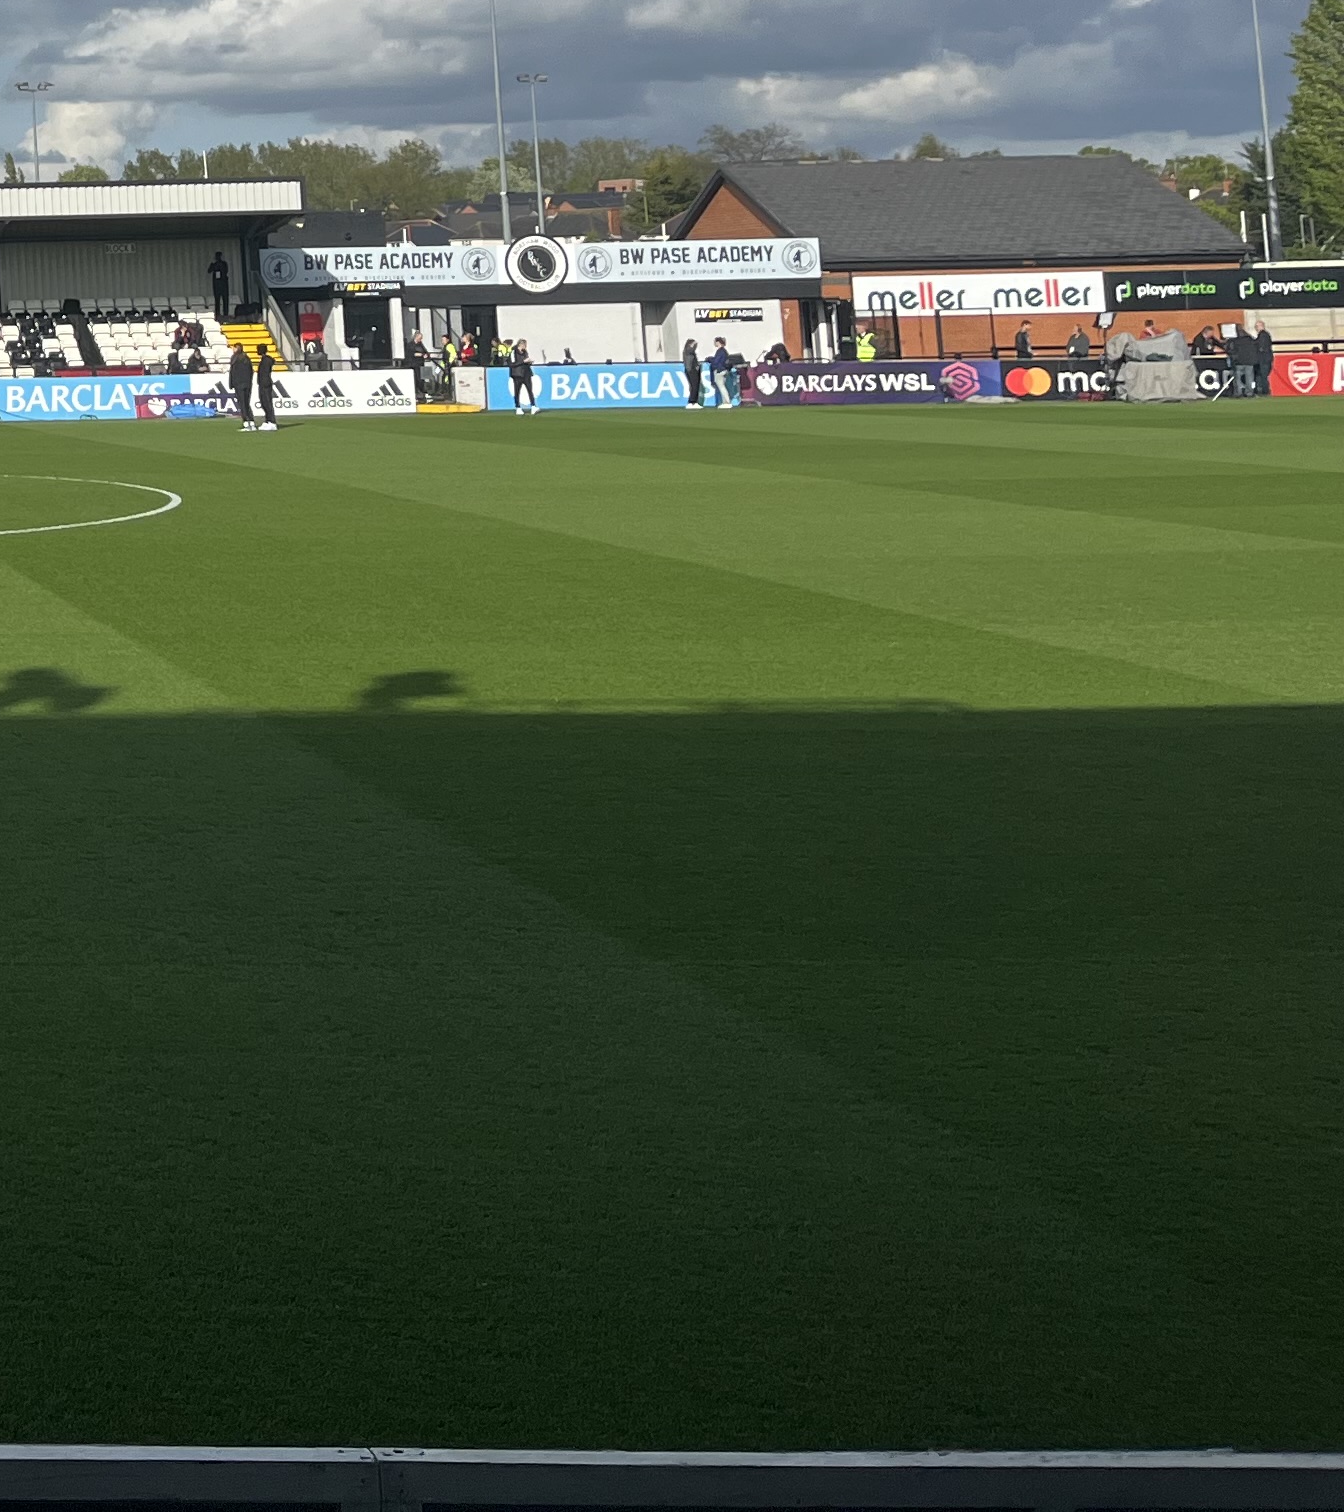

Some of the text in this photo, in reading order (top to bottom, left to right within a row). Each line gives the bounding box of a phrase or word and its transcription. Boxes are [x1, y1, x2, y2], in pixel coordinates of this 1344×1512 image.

[304, 254, 328, 271] BW
[335, 253, 373, 270] PASE
[380, 252, 453, 270] ACADEMY
[620, 248, 644, 265] BW
[651, 247, 691, 264] PASE
[697, 245, 773, 263] ACADEMY
[868, 279, 1091, 310] meller meller
[1137, 279, 1338, 298] playerdata playerdata
[782, 373, 935, 393] BARCLAYS WSL
[255, 395, 412, 409] adas adidas adidas
